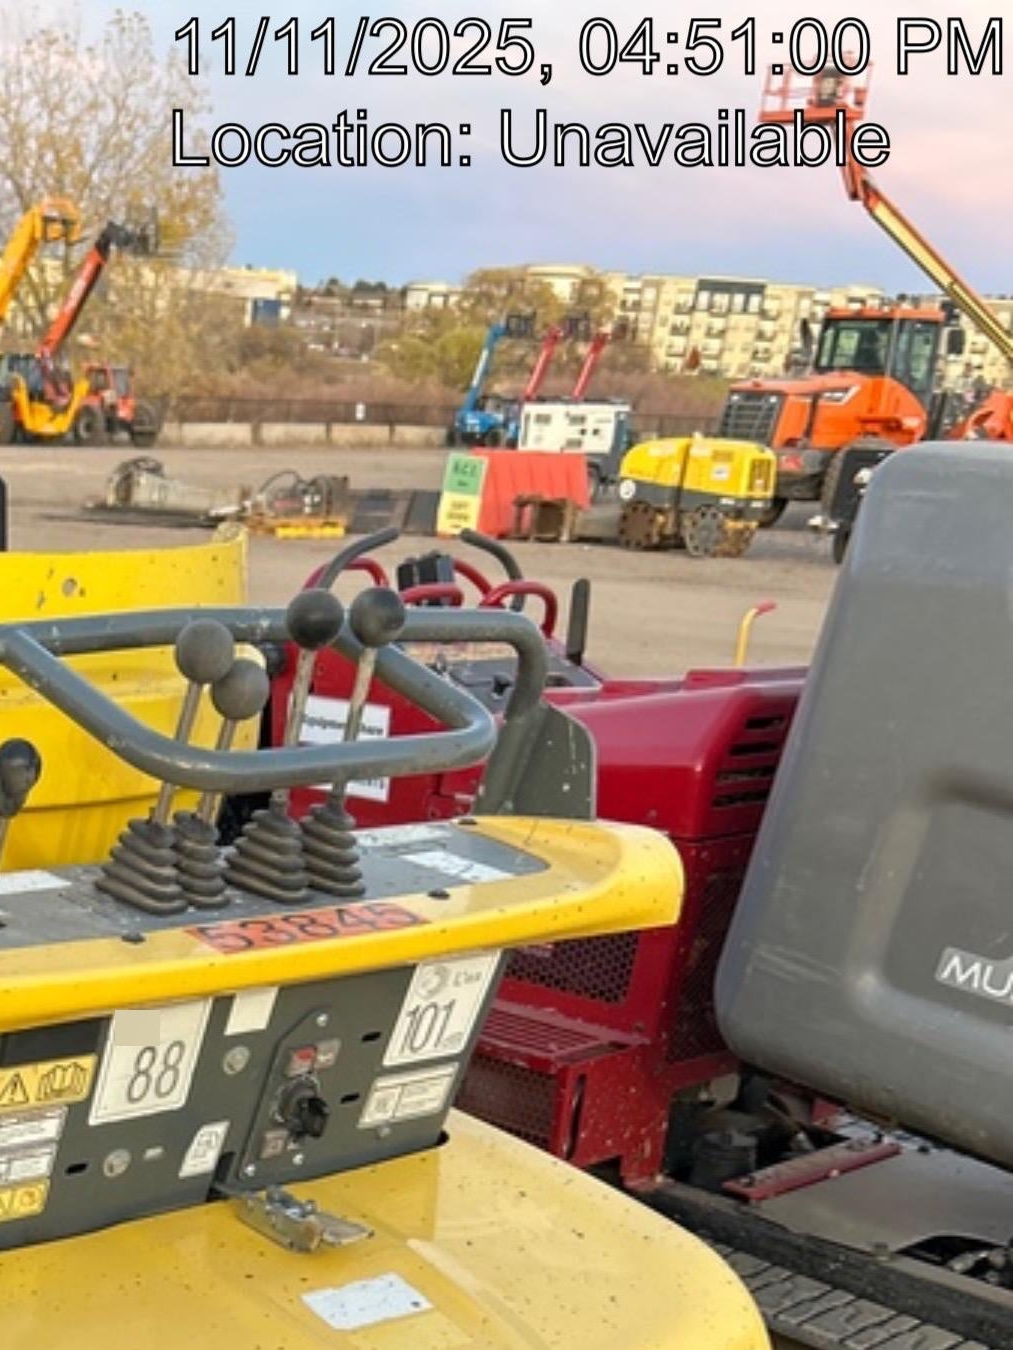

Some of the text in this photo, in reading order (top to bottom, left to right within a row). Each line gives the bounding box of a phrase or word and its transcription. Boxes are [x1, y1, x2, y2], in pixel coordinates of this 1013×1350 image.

[196, 902, 419, 950] 53845
[401, 1000, 456, 1055] 101
[126, 1040, 186, 1104] 88
